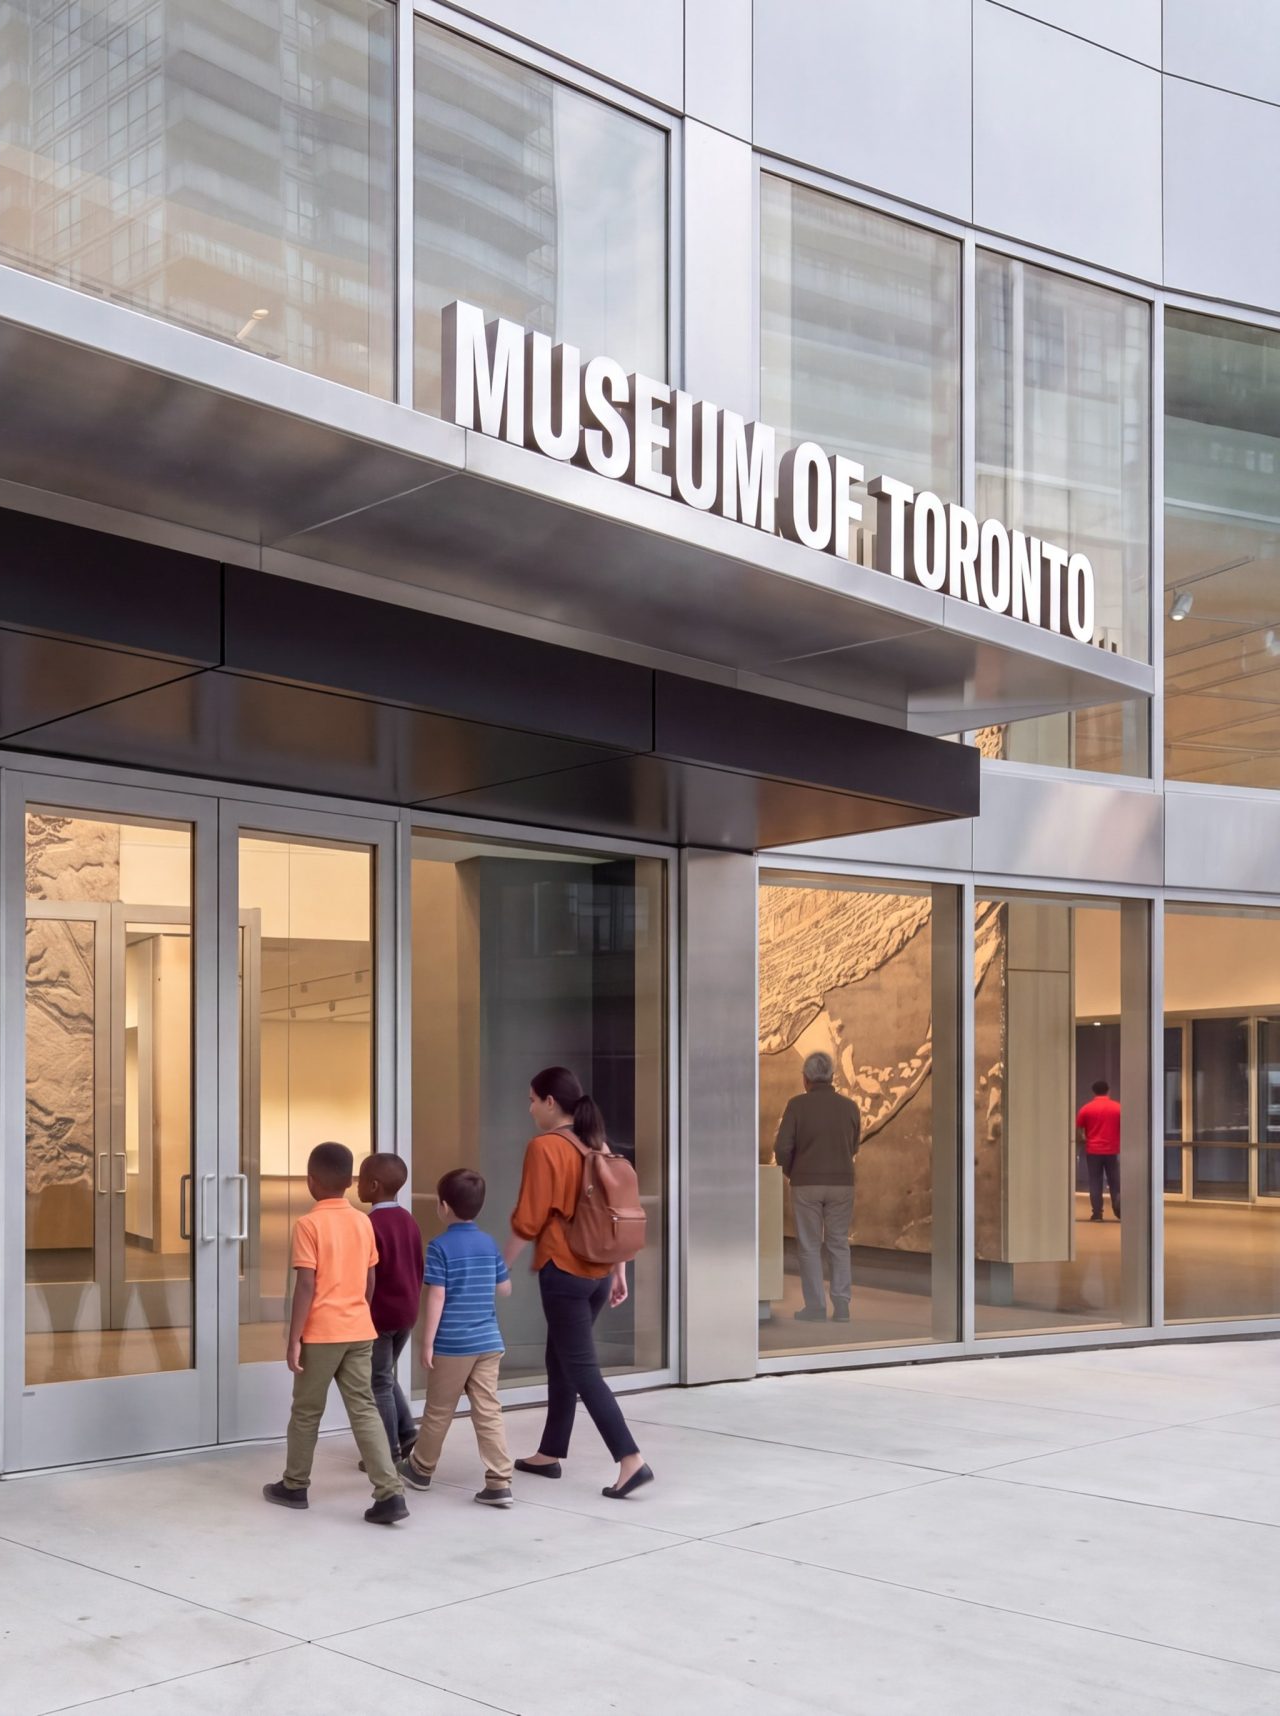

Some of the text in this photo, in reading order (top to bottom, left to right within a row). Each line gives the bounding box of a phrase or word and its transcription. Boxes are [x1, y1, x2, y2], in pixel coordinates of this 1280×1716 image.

[442, 300, 1095, 645] MUSEUM OF TORONTO
